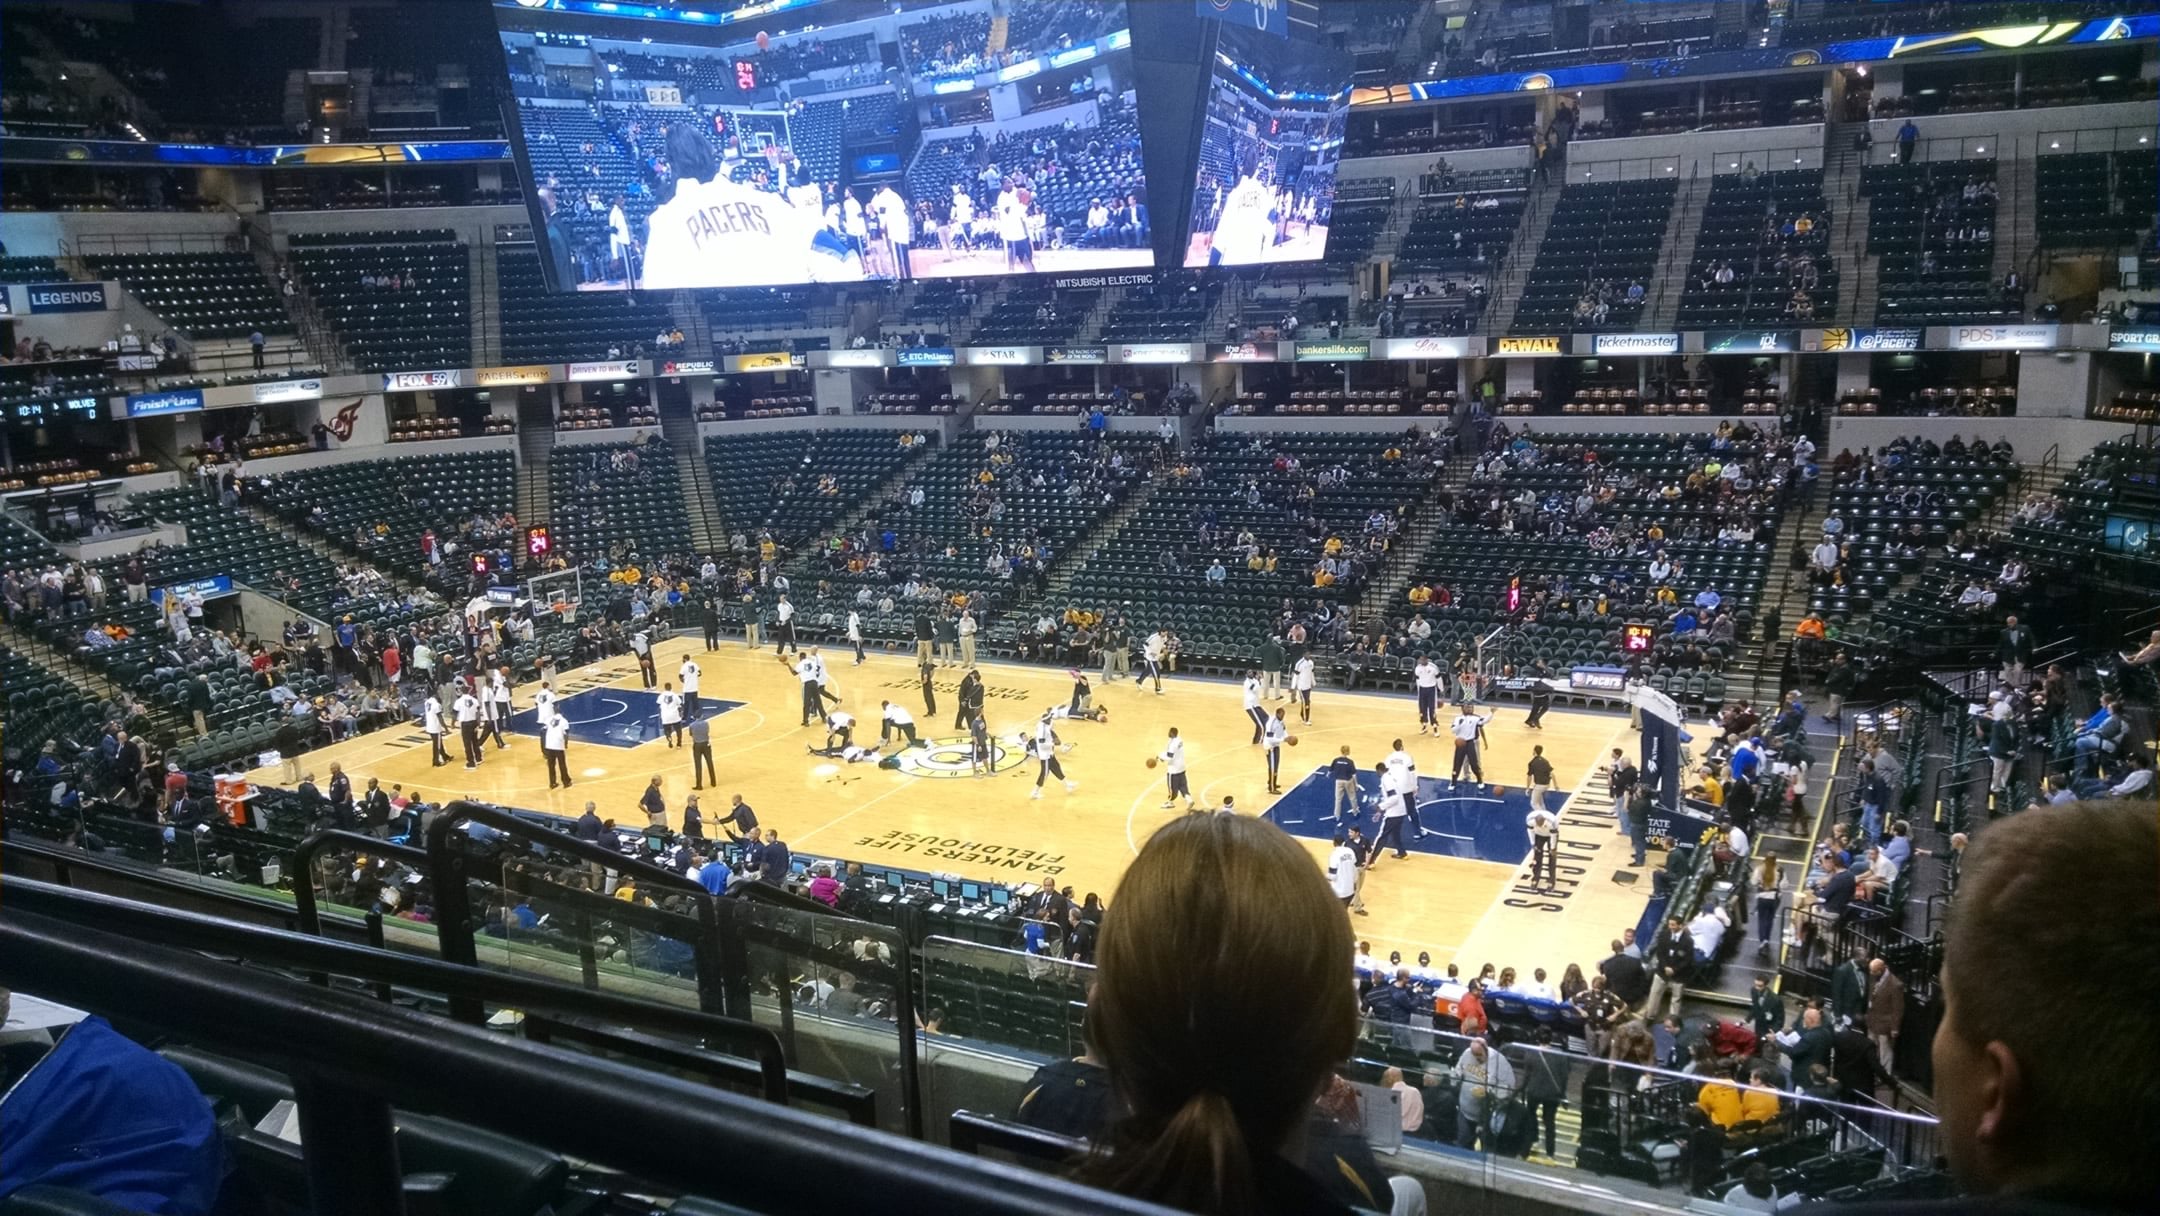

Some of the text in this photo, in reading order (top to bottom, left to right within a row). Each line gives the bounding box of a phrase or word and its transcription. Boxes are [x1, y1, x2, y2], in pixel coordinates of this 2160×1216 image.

[685, 201, 771, 251] PACERS
[1056, 274, 1153, 288] MITSUBISHI ELECTRIC
[32, 290, 102, 305] LEGENDS
[1599, 335, 1676, 348] ticketmaster
[1859, 334, 1918, 349] @Pacers
[1959, 328, 1993, 342] PDS
[2110, 333, 2144, 343] SPORT
[990, 351, 1015, 359] STAR
[1297, 344, 1368, 355] bankerslife.com
[676, 361, 714, 369] REPUBLIC
[791, 354, 806, 365] CAT
[572, 365, 597, 374] DRIVEN
[599, 365, 606, 373] TO
[398, 373, 448, 386] FOX 59
[133, 396, 198, 411] Finish Line
[531, 537, 546, 552] 24
[1630, 637, 1646, 649] 24
[1585, 675, 1622, 687] Pacers
[1648, 818, 1671, 829] TATE
[1648, 827, 1668, 837] HAT
[883, 830, 1066, 864] FIELDHOUSE
[854, 836, 1066, 876] BANKERS LIFE
